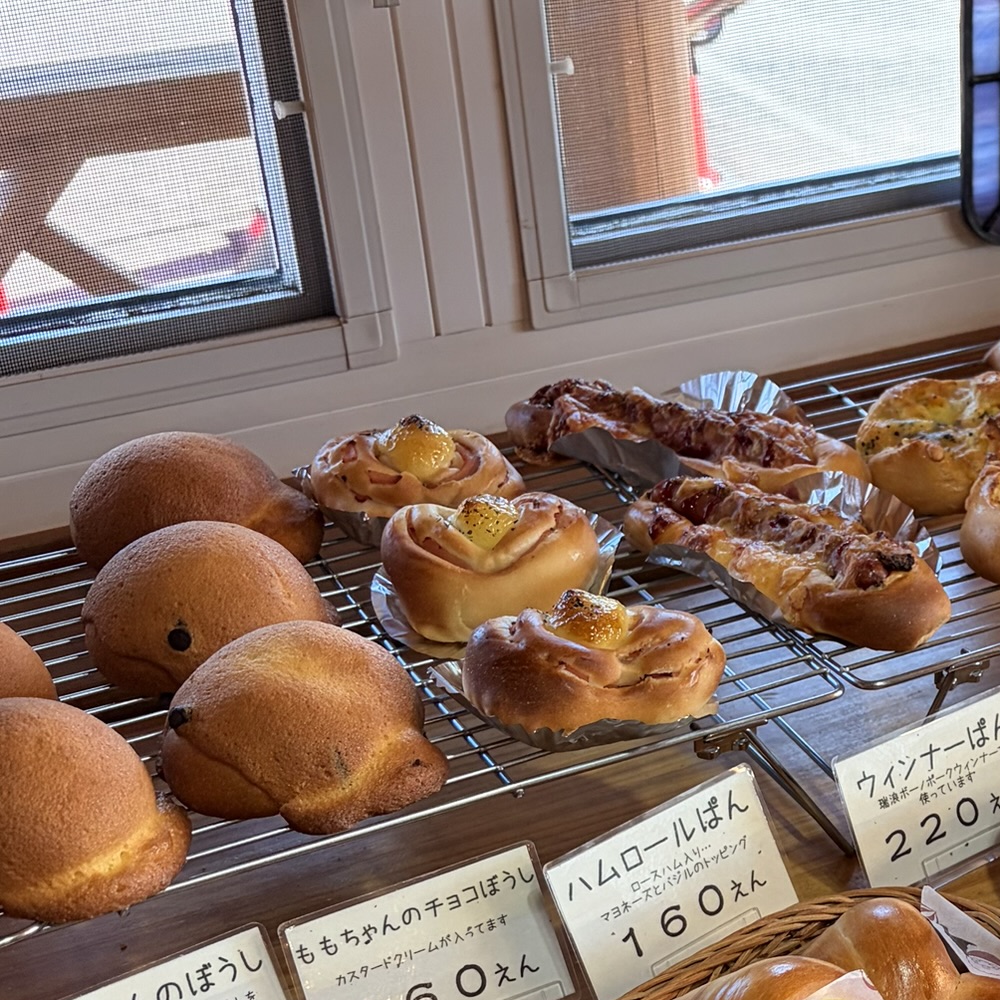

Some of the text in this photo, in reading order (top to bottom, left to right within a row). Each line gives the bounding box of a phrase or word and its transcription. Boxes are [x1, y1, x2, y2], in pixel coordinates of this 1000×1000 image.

[919, 771, 976, 806] 使っています
[569, 790, 749, 901] ハムロールぱん
[600, 835, 748, 922] マヨネーズとバジルのトッピング
[296, 867, 534, 964] ももちゃんのチョコぼうし
[335, 914, 508, 986] カスタードクリームが入ってます
[622, 870, 767, 957] 160えん
